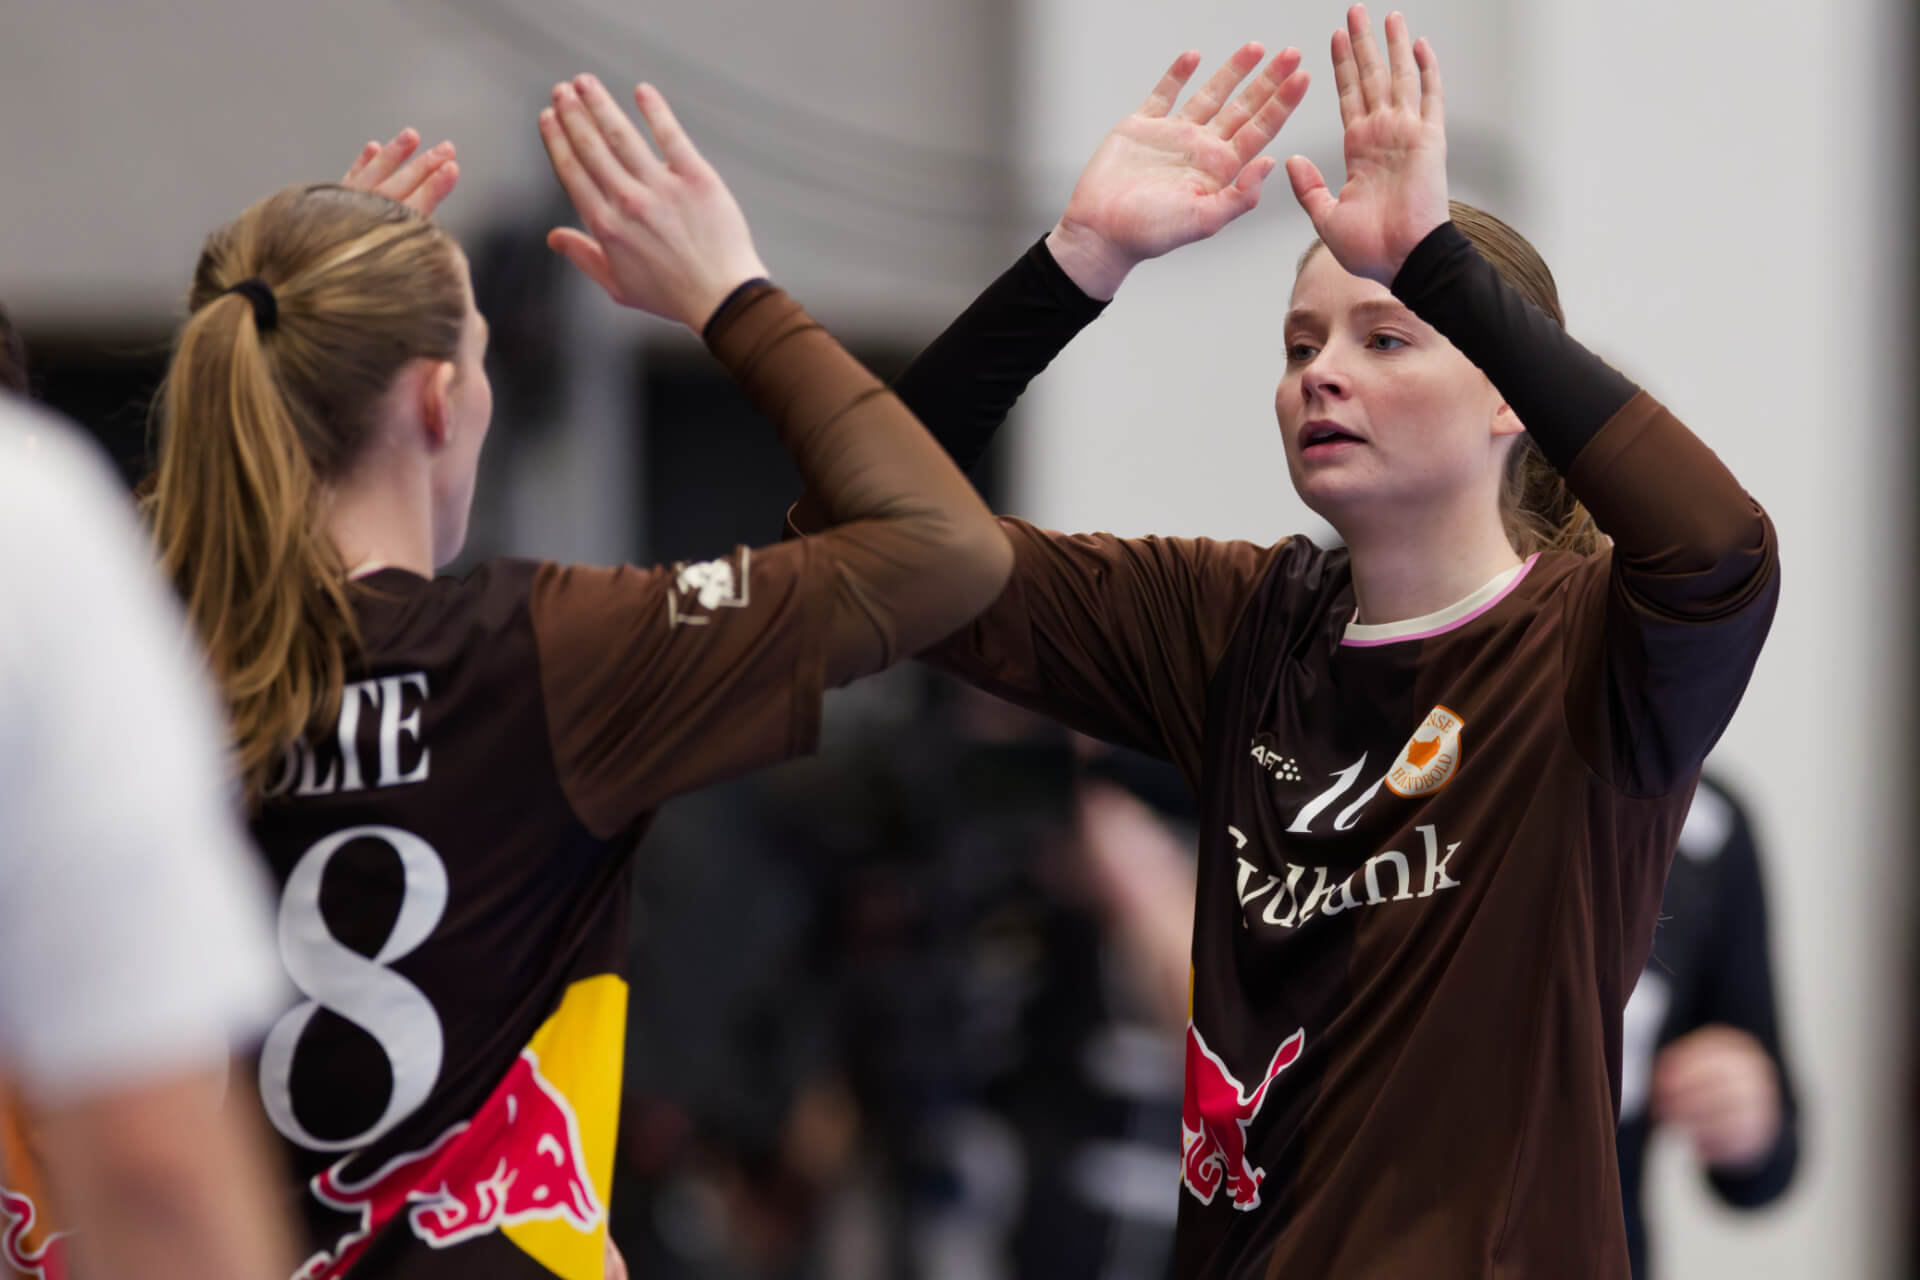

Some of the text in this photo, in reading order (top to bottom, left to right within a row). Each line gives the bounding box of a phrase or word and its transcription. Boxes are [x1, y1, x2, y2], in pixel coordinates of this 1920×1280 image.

[1425, 712, 1454, 734] NSE
[1251, 739, 1283, 771] AFT
[1391, 753, 1452, 791] HANDBOLD
[259, 825, 448, 1152] 8
